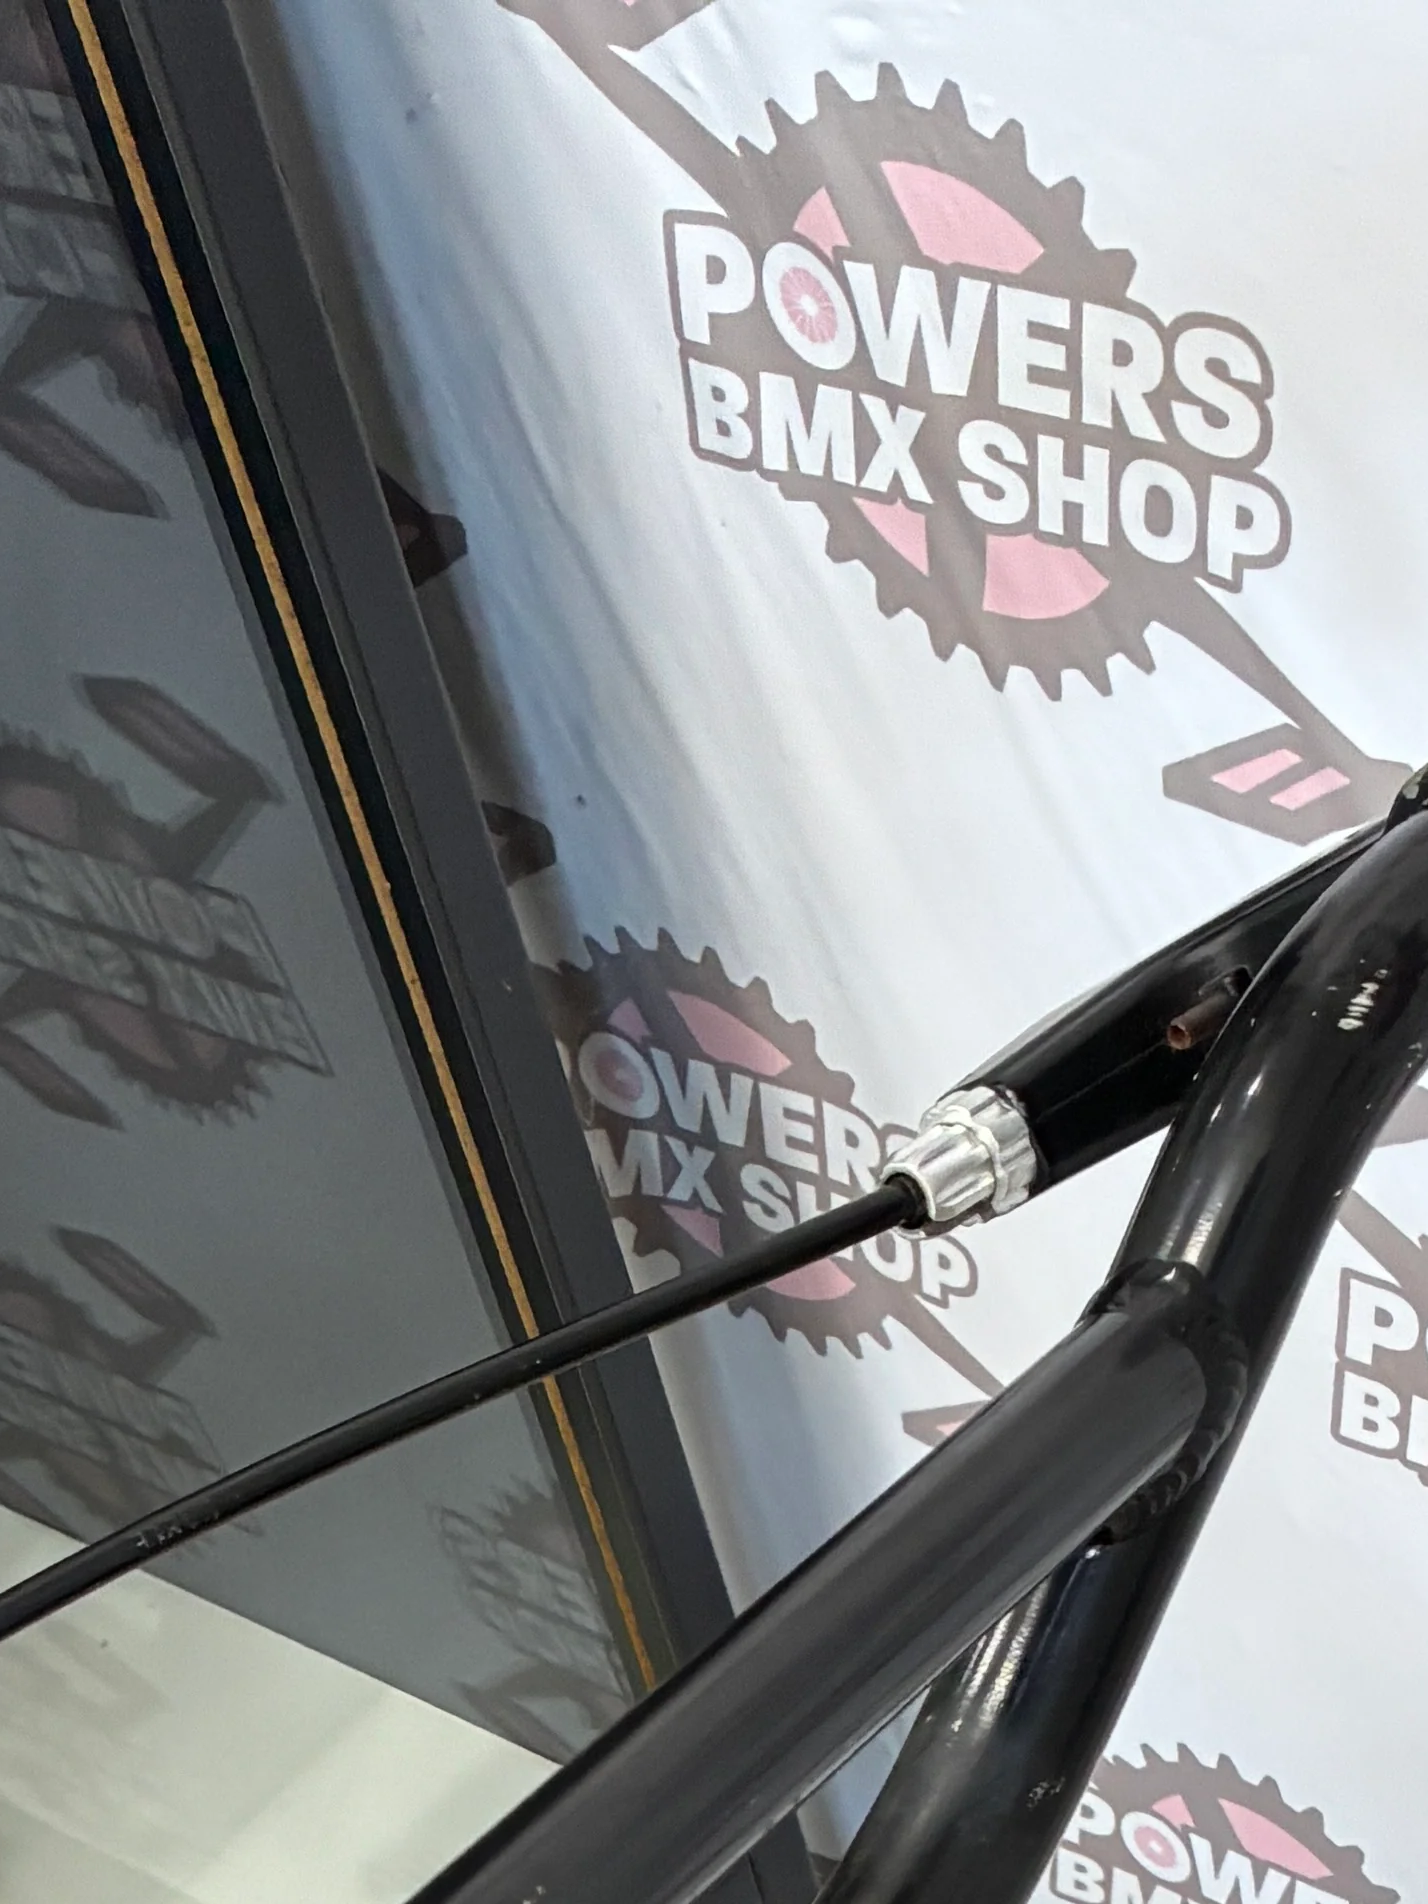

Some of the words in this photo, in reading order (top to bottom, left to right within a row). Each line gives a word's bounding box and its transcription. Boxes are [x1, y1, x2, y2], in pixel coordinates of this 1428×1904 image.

[673, 220, 1267, 462] POWERS
[686, 359, 935, 506] BMX
[956, 418, 1284, 582] SHOP
[577, 1031, 918, 1197] OWER
[583, 1128, 724, 1216] MX
